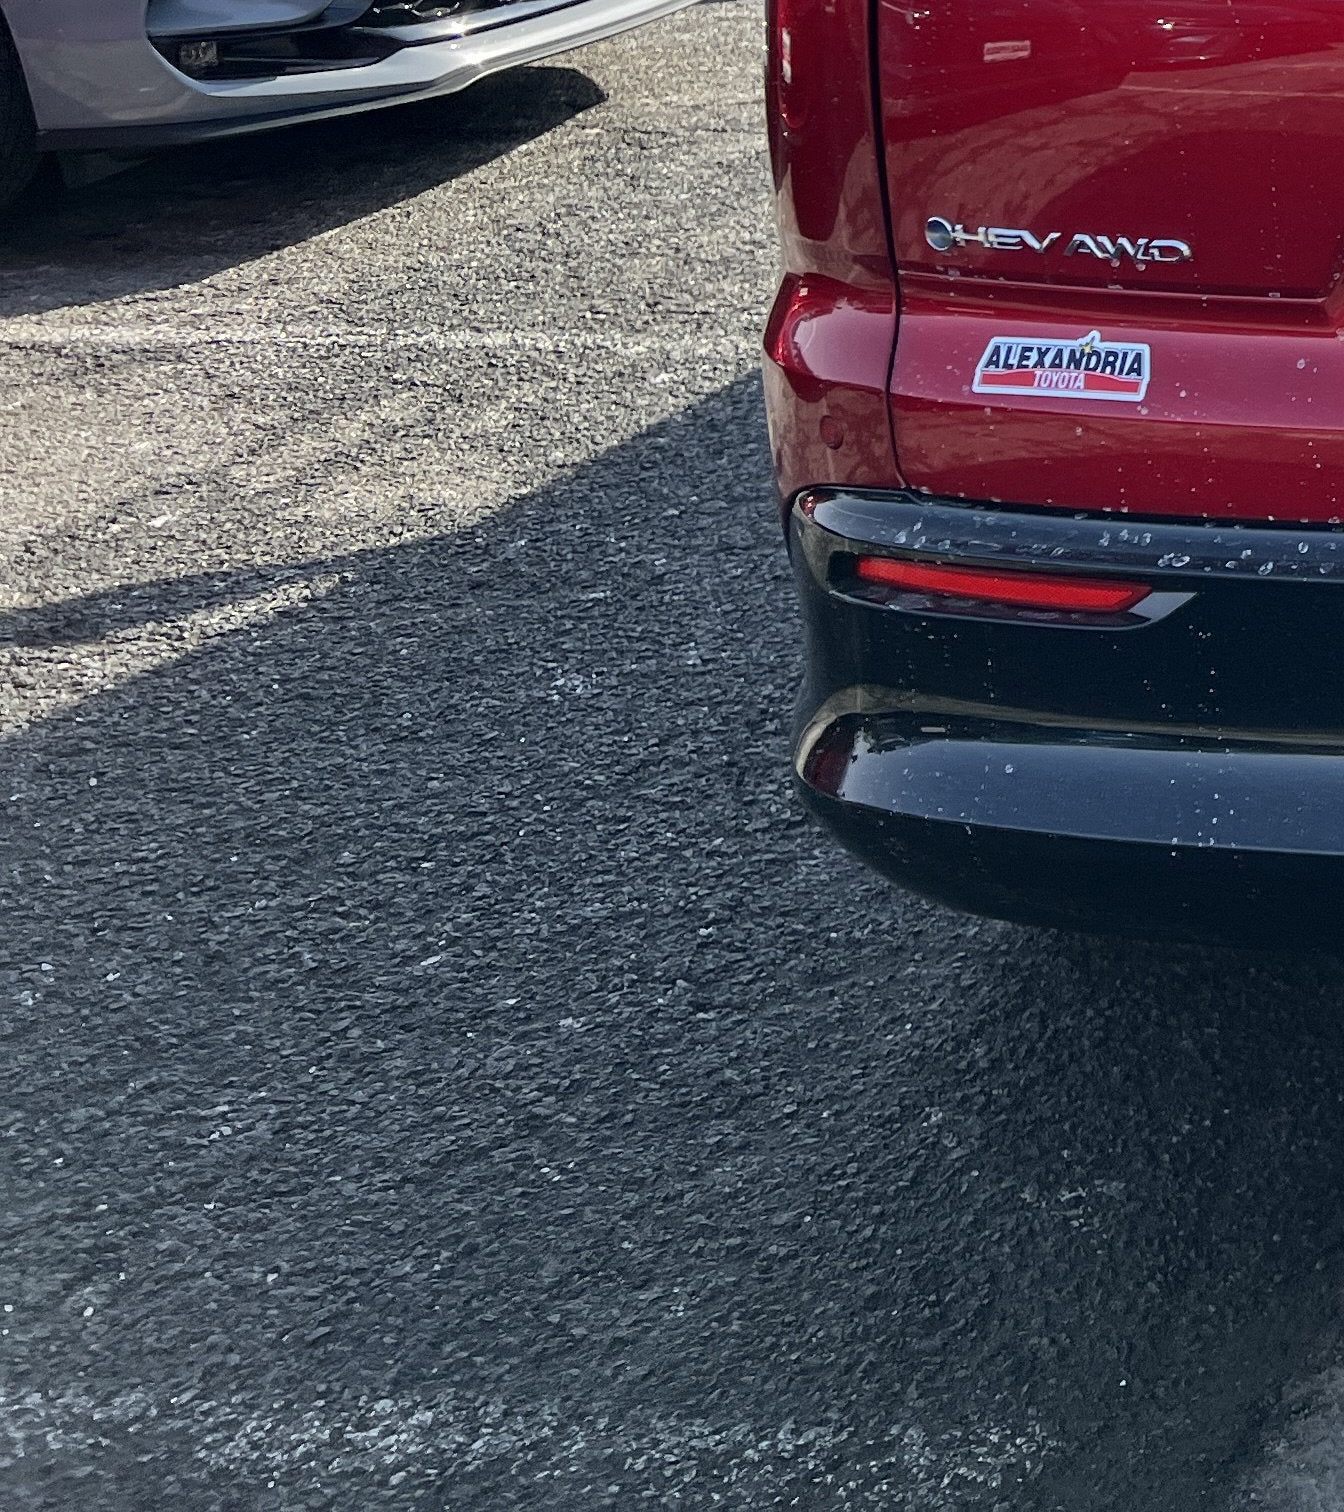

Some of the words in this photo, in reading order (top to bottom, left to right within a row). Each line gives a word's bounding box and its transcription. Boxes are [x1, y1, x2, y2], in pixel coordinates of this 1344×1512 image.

[951, 223, 1062, 255] HEV
[1064, 232, 1193, 263] AWD
[983, 343, 1143, 378] ALEXANDRIA
[1032, 370, 1087, 390] TOYOTA
